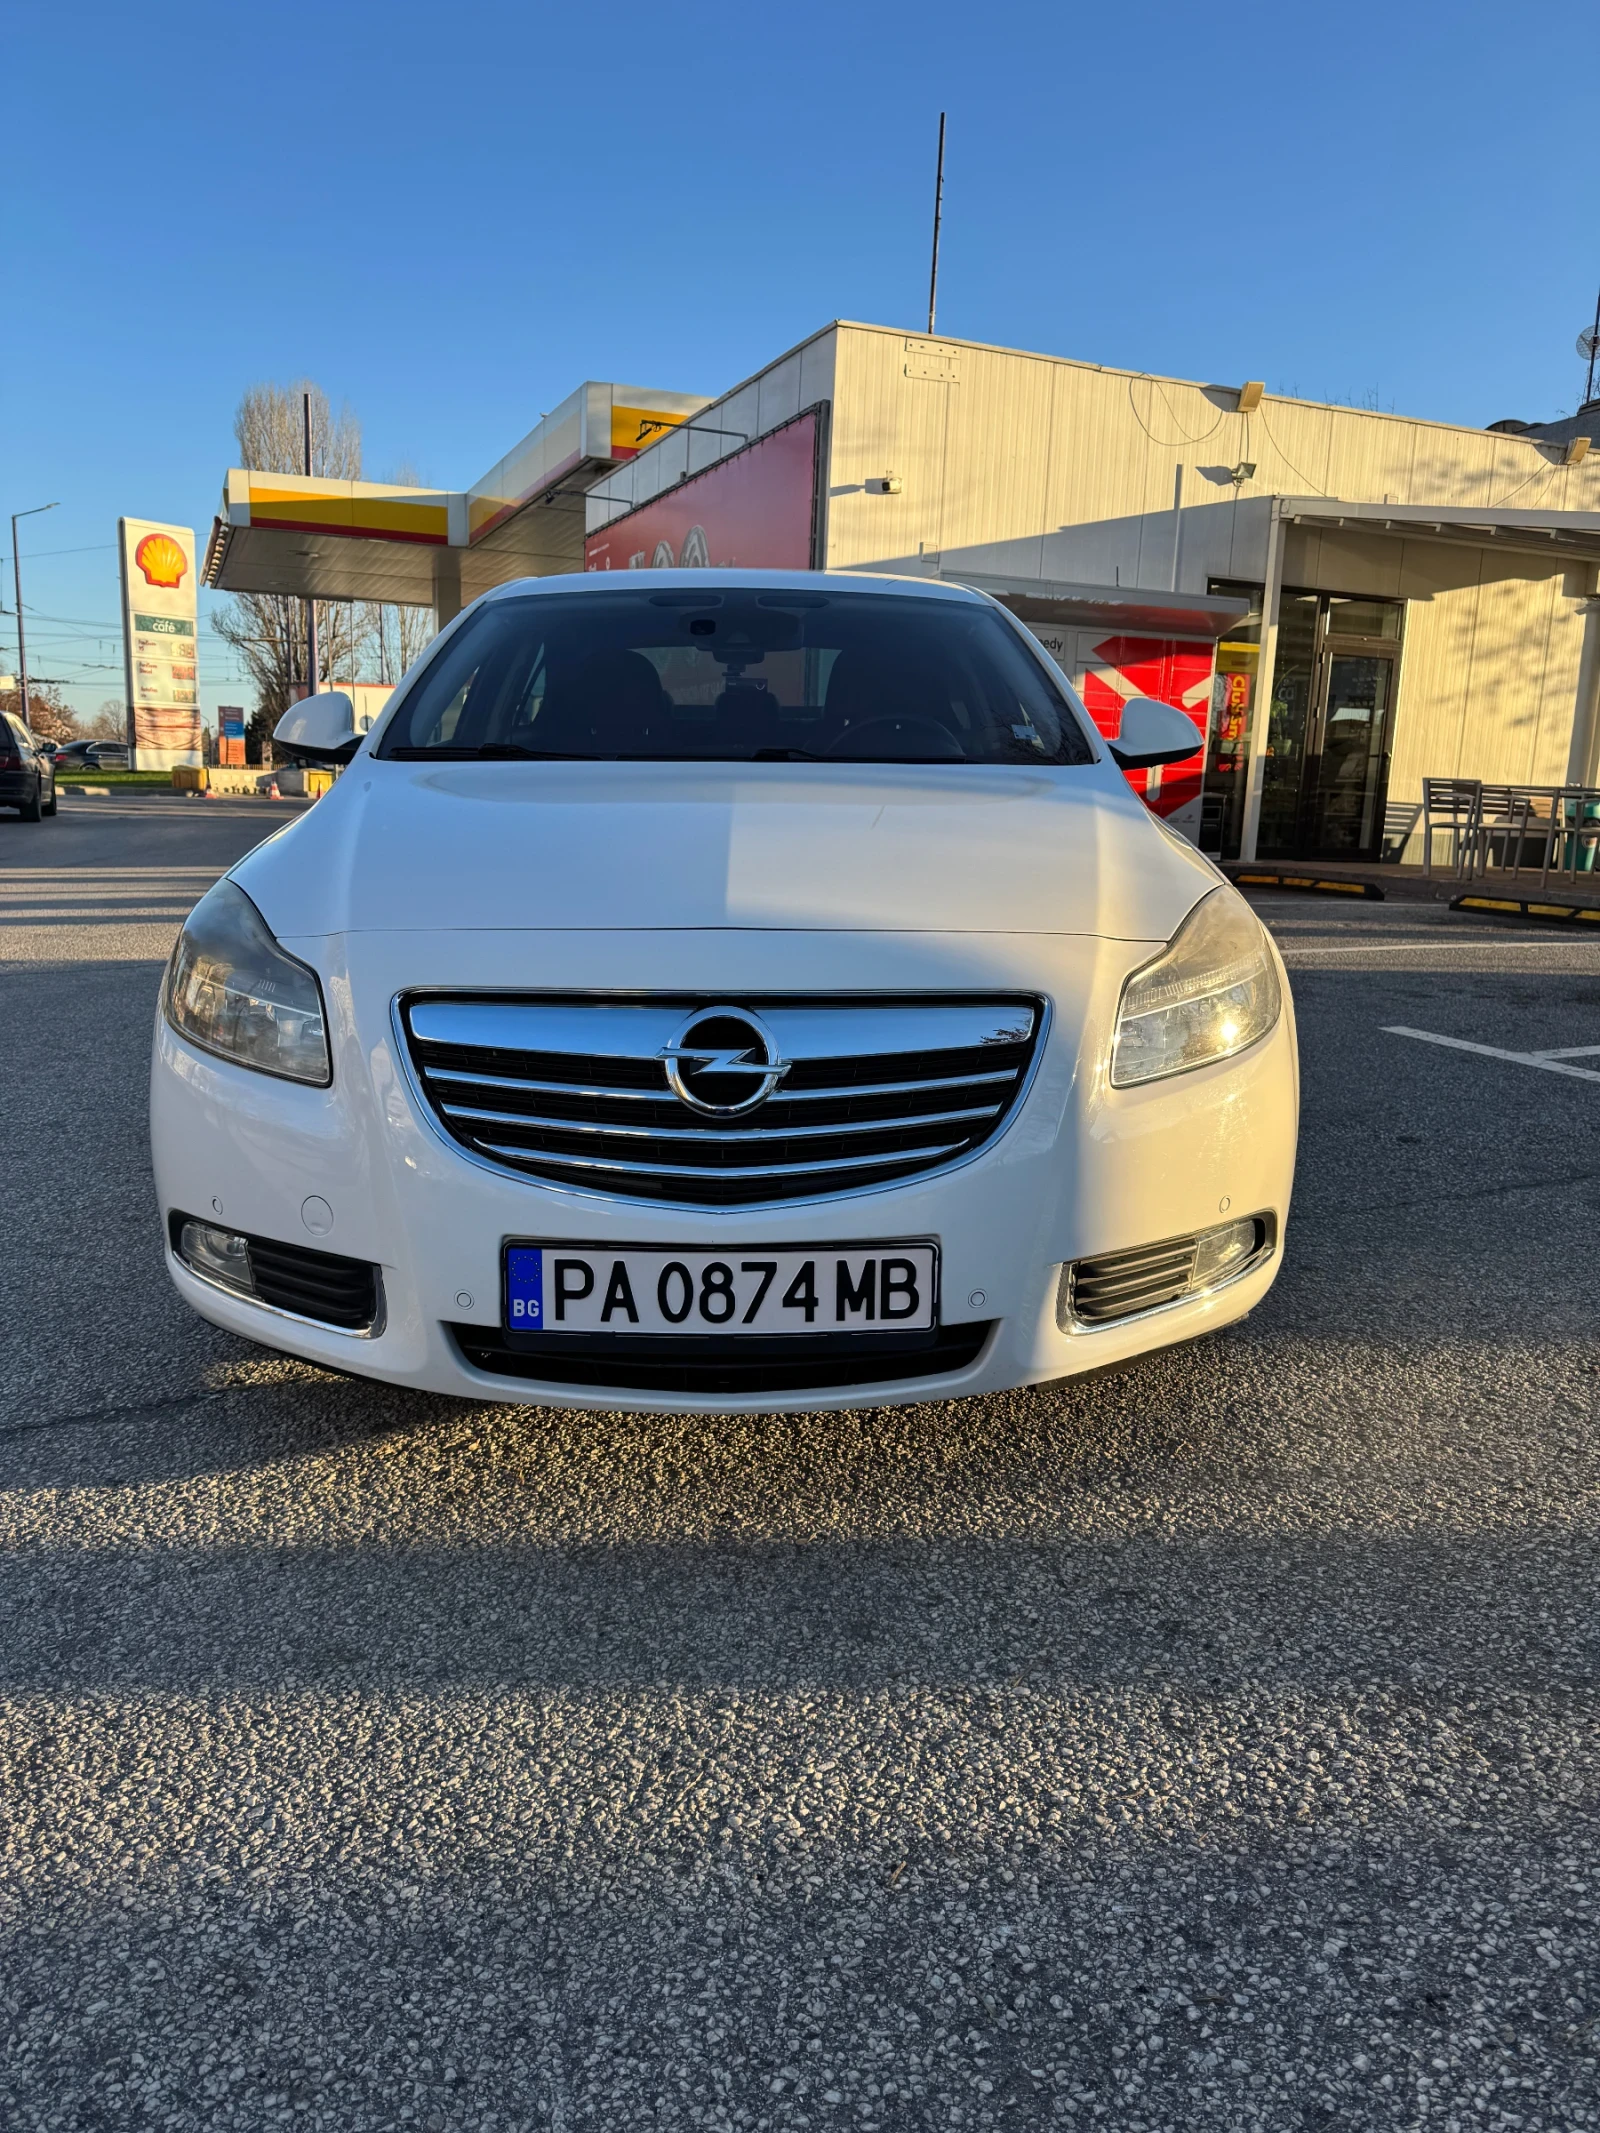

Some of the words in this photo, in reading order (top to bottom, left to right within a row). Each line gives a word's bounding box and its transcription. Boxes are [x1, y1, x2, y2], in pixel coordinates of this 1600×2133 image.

[513, 1298, 539, 1318] BG
[553, 1258, 640, 1323] PA
[657, 1260, 819, 1324] 0874
[835, 1257, 920, 1322] MB
